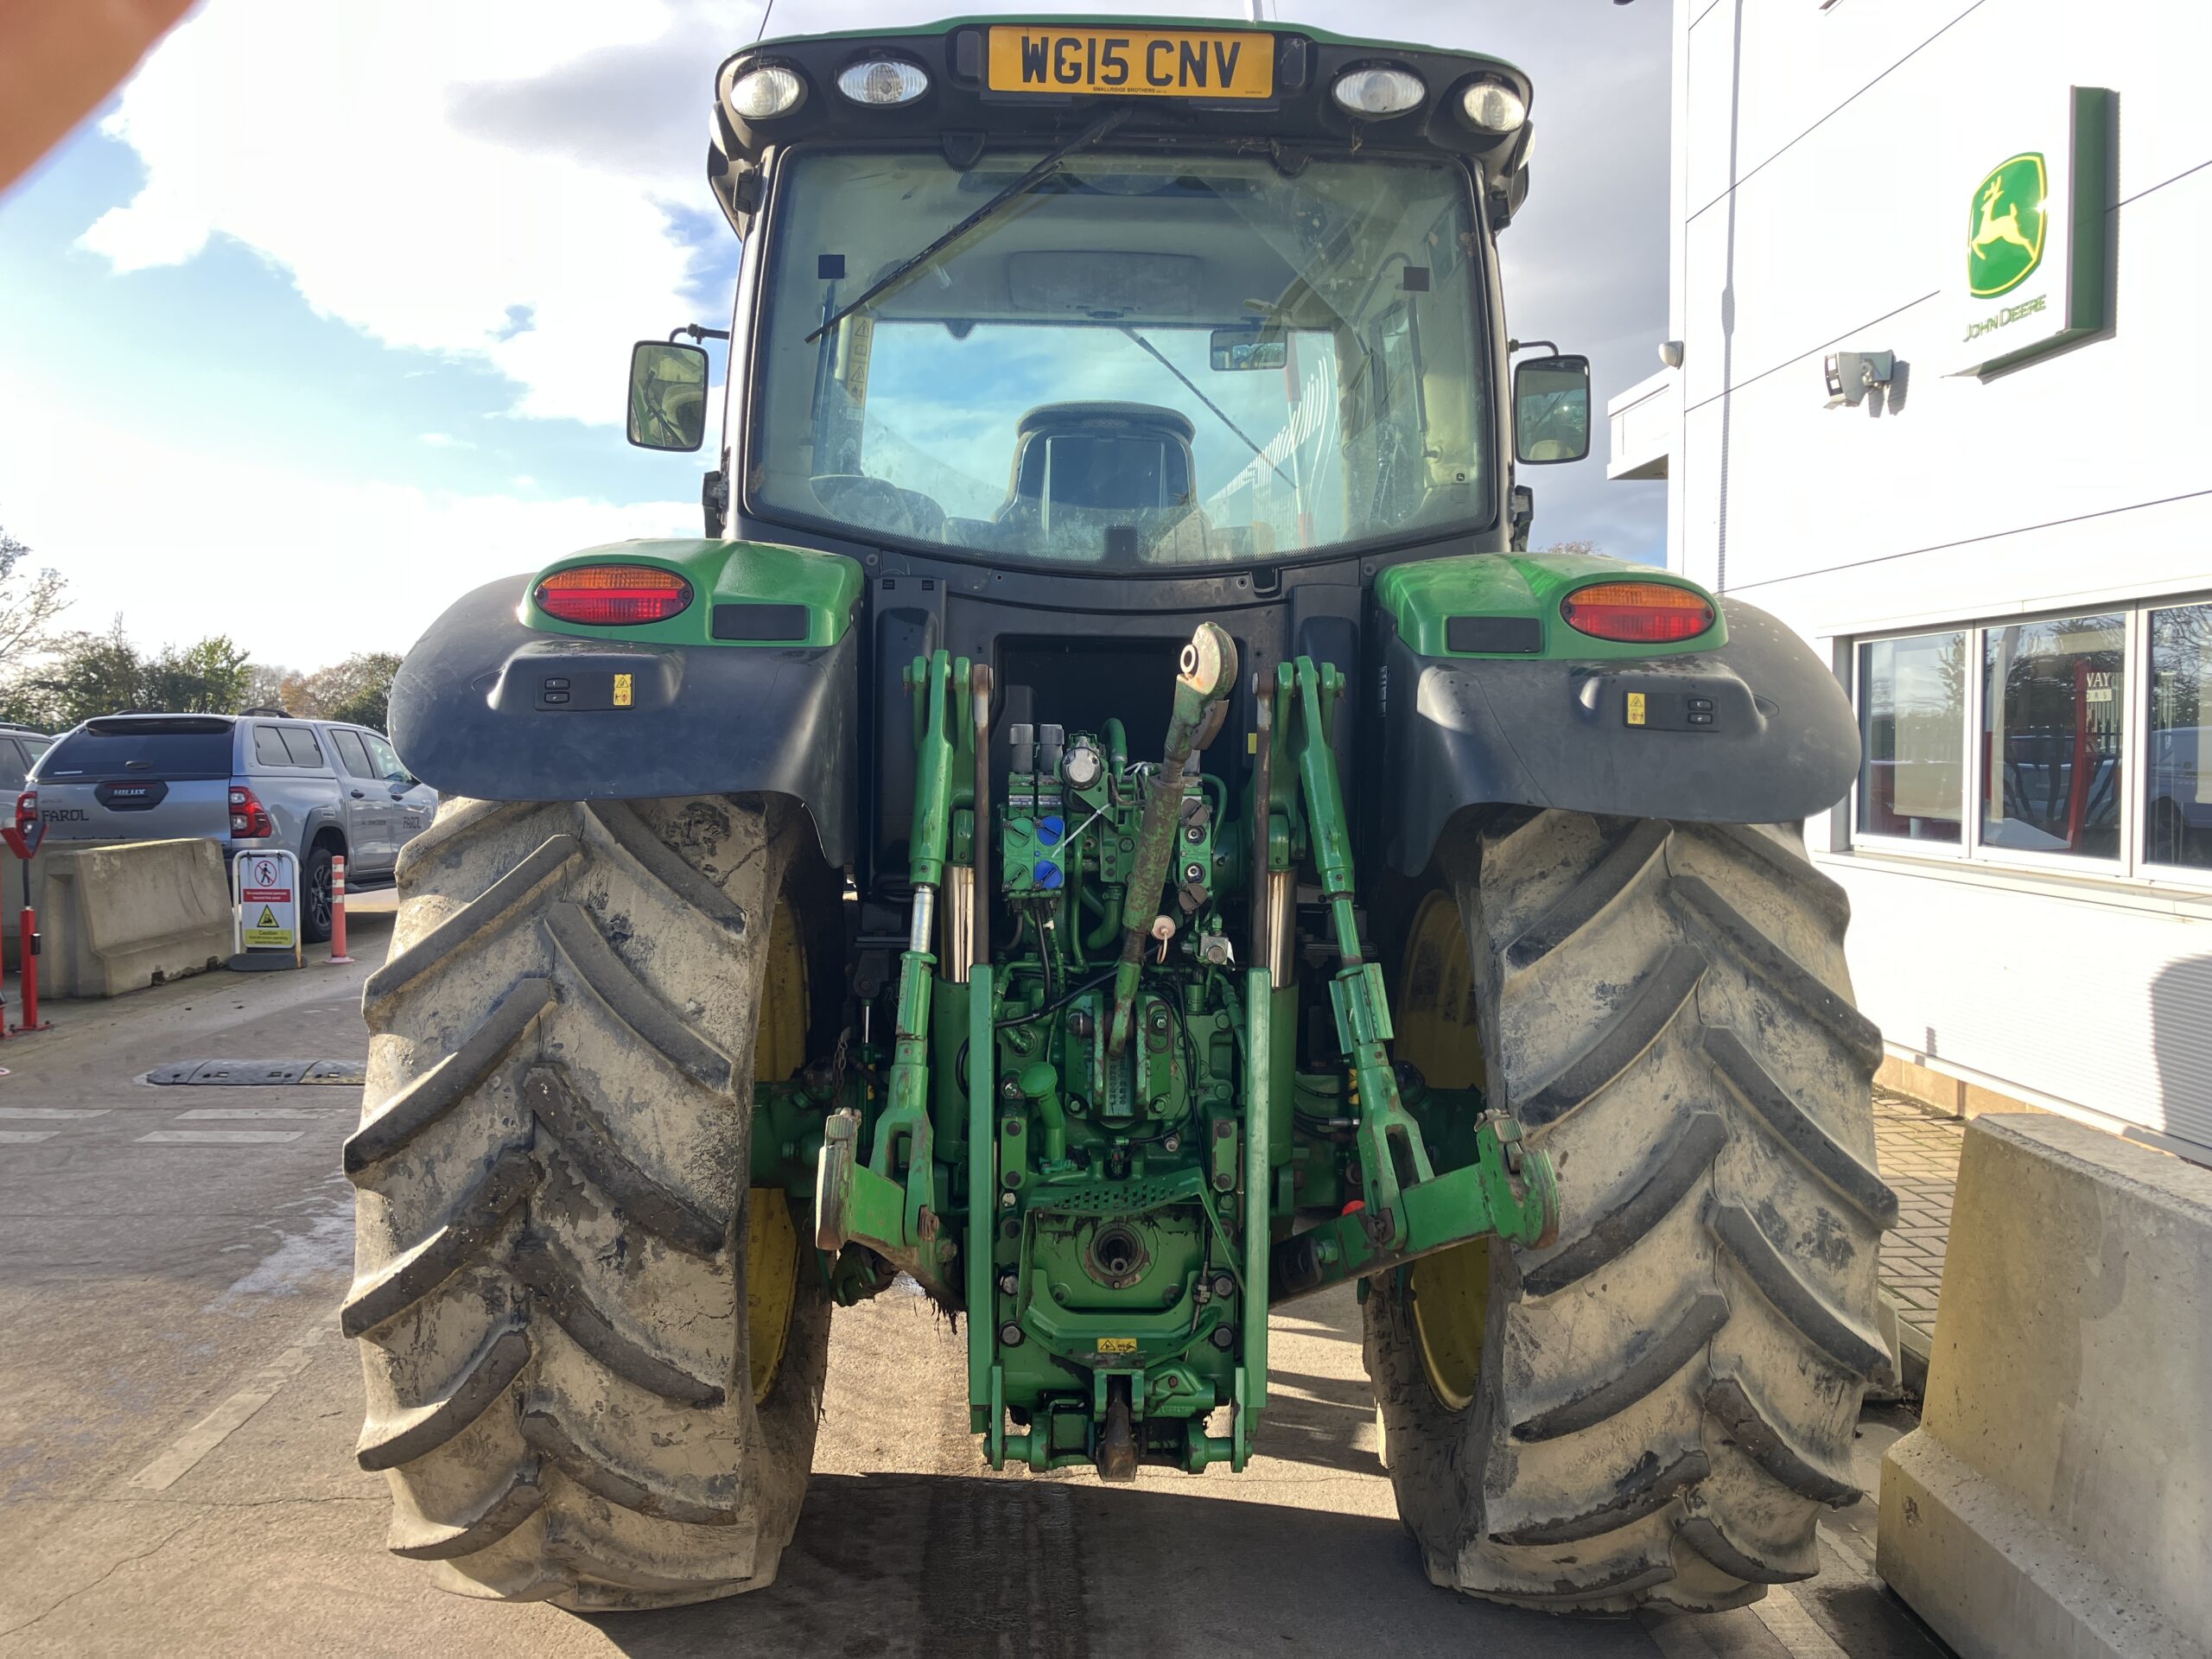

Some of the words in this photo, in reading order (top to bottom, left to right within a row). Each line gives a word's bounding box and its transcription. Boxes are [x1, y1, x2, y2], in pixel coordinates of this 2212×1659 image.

[1021, 36, 1129, 85] WG15
[1146, 40, 1242, 88] CNV
[1962, 315, 1999, 342] JOHN
[1999, 294, 2047, 327] DEERE
[41, 810, 89, 822] FAROL
[403, 816, 422, 830] FAROL
